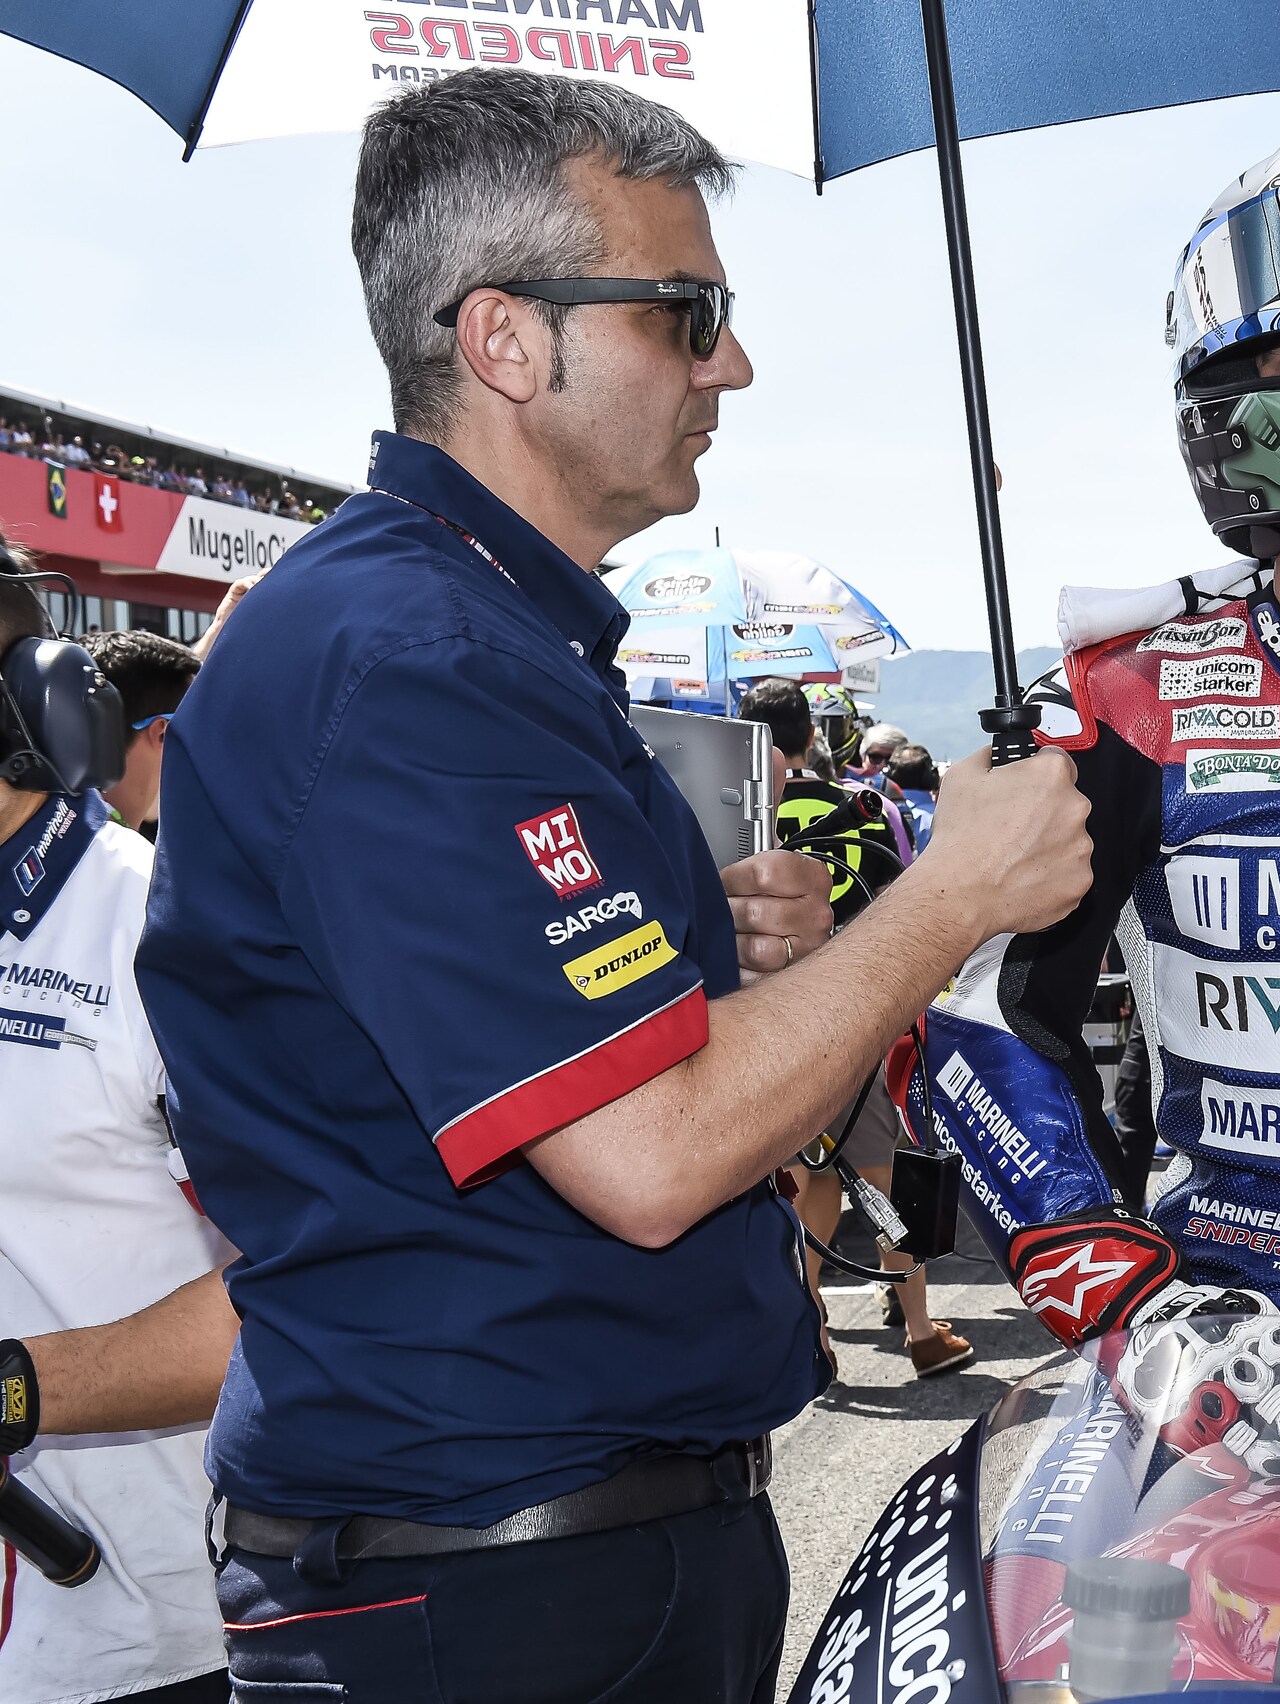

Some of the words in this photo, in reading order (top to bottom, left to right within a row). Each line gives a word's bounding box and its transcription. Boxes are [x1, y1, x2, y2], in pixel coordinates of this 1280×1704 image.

[1194, 676, 1256, 692] starker
[1195, 659, 1255, 676] unicom
[1177, 707, 1275, 731] RIVACOLD
[521, 812, 575, 861] MI
[538, 849, 592, 890] MO
[593, 936, 662, 981] DUNLOP
[3, 985, 102, 1017] cucine
[7, 963, 111, 1006] MARINELLI
[0, 1017, 44, 1040] NELLI
[957, 1100, 1021, 1184] cucine
[966, 1078, 1048, 1180] MARINELLI
[1024, 1393, 1128, 1544] ARINELLI
